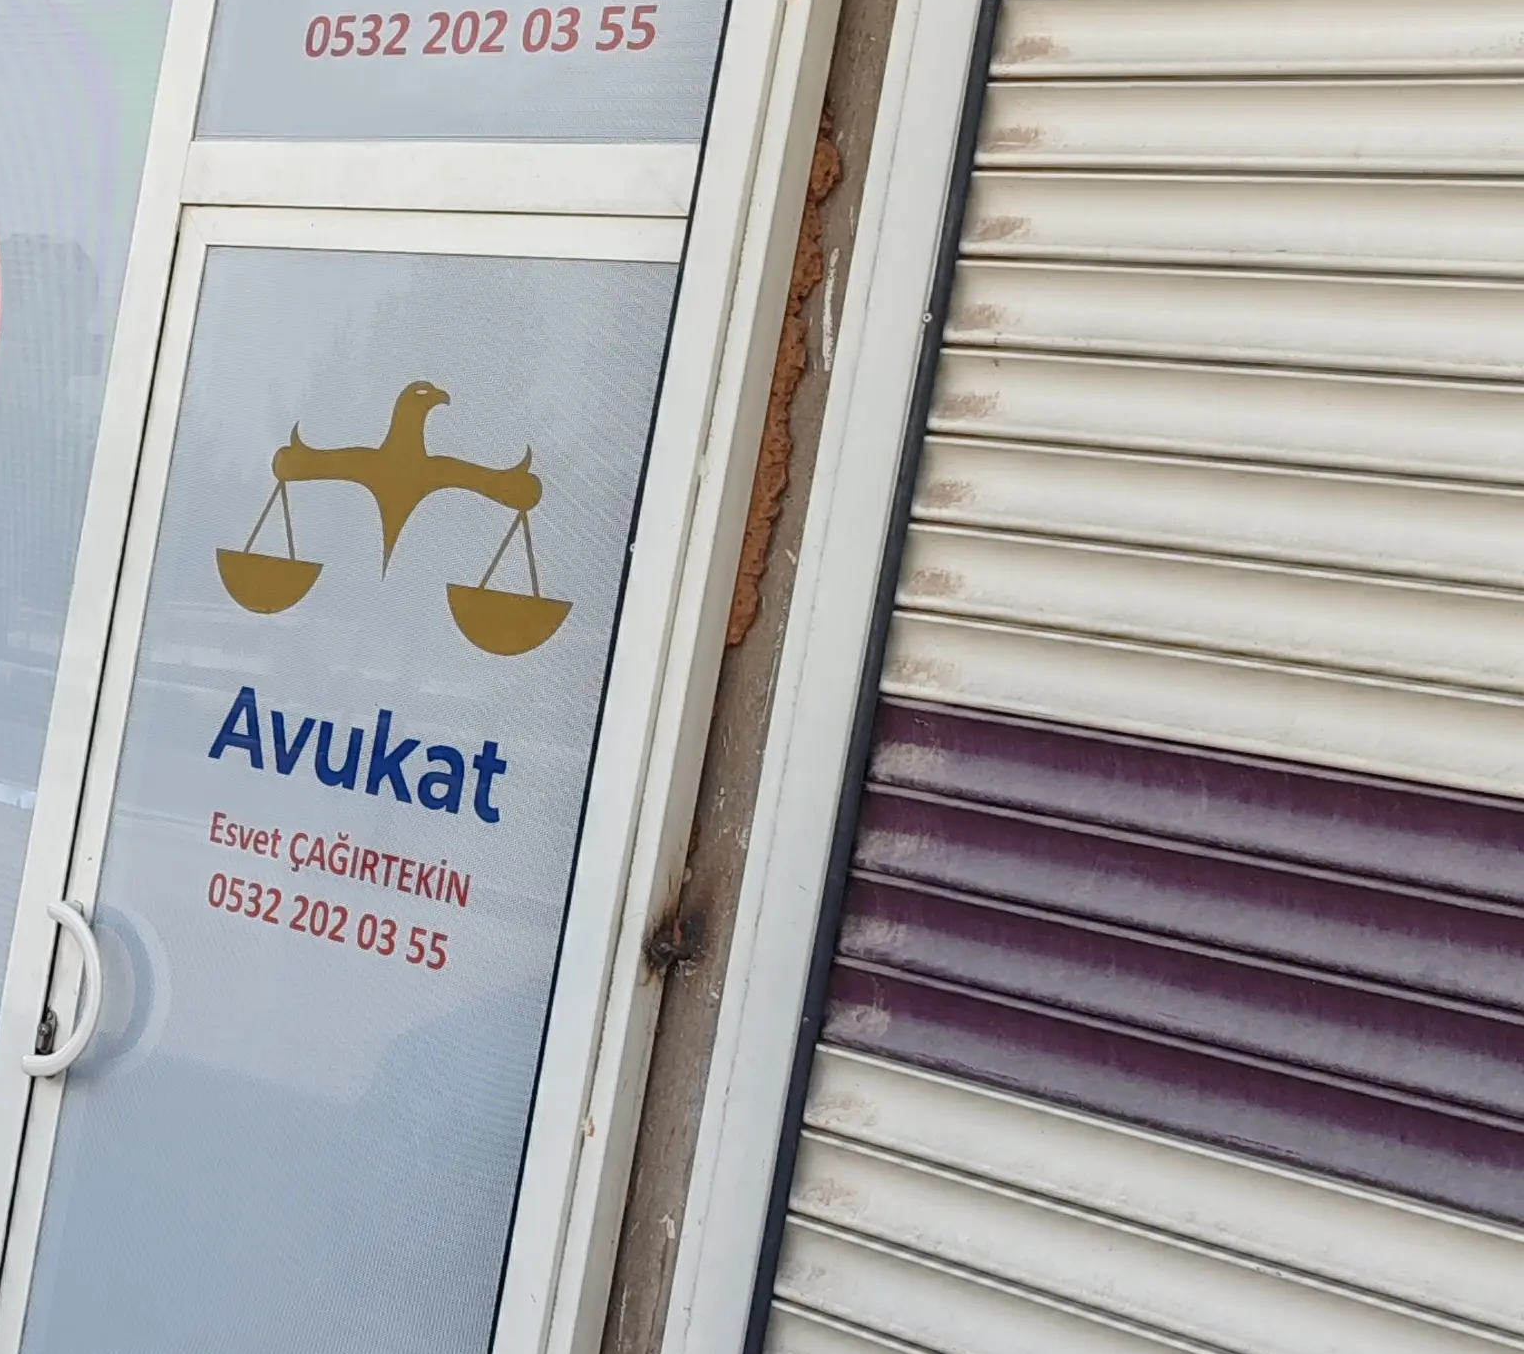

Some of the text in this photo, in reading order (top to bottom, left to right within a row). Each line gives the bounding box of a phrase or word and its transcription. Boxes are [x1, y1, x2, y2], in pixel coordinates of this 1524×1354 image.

[305, 4, 658, 58] 0532 202 03 55
[208, 686, 507, 824] Avukat
[210, 811, 471, 908] Esvet ÇAĞIRTEKİN
[208, 873, 448, 970] 0532 202 03 55
